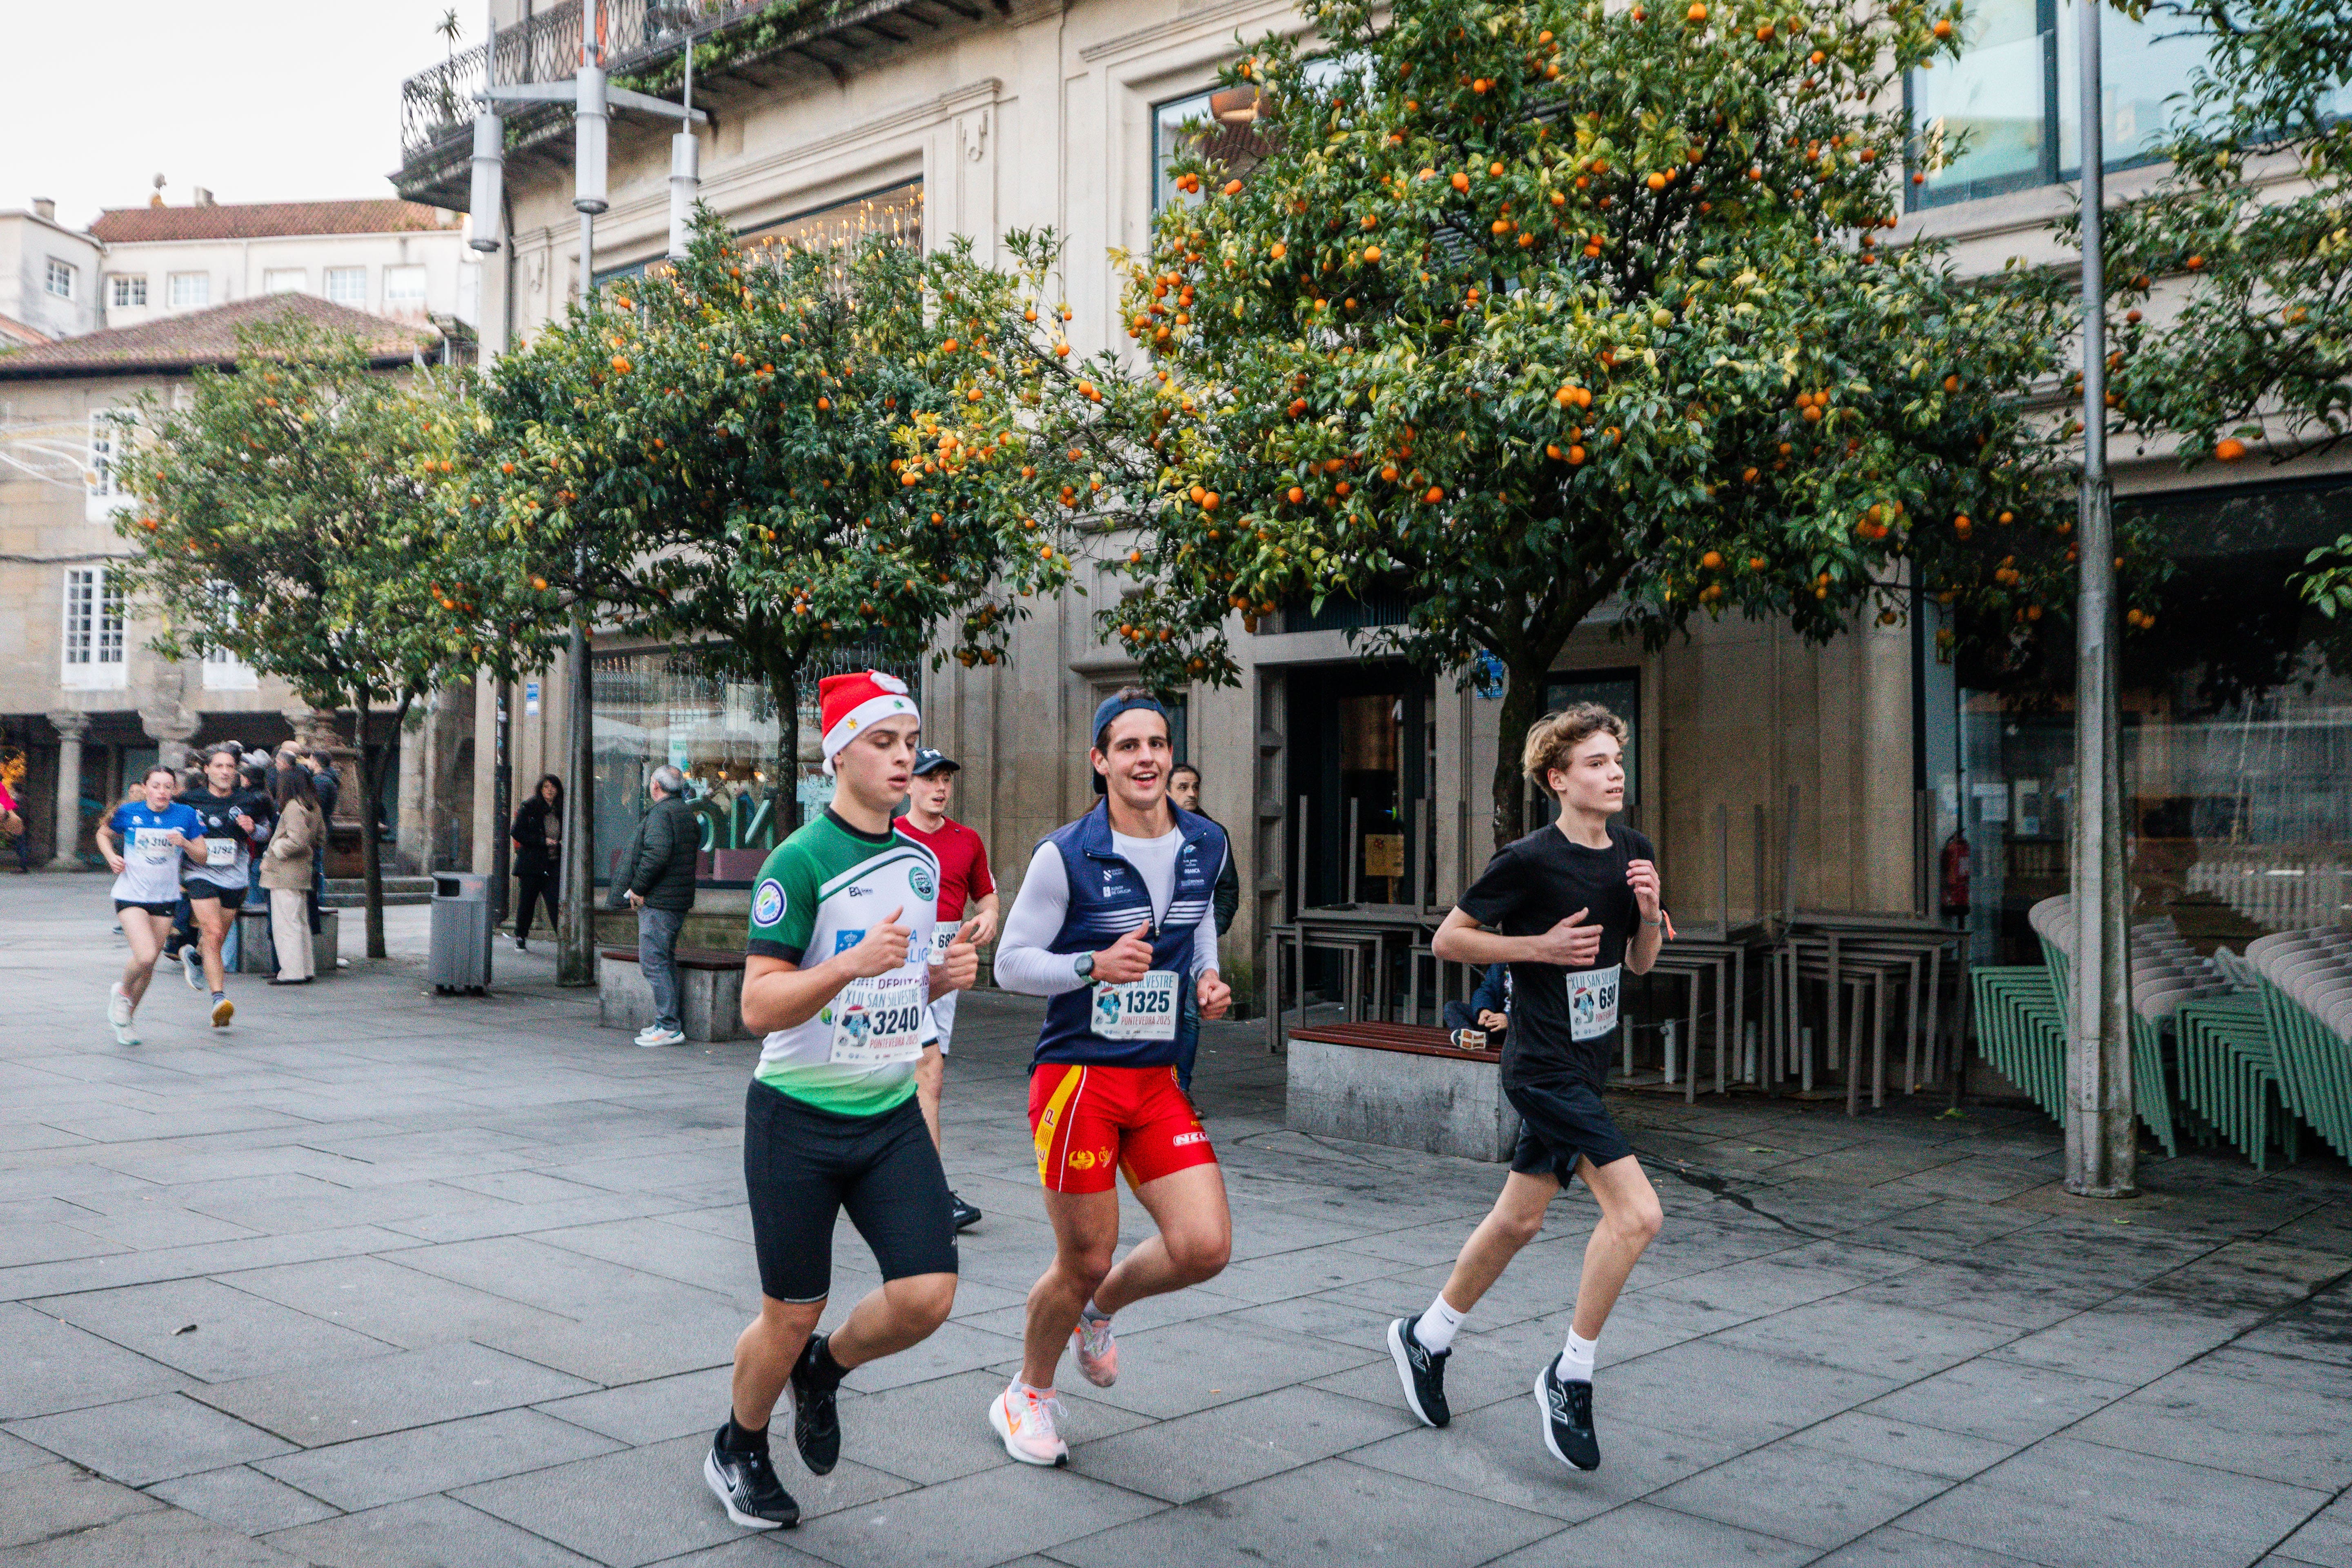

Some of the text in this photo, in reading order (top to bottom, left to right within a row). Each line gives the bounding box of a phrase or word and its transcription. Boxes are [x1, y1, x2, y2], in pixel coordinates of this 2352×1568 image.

[1571, 975, 1585, 990] XLII
[1587, 973, 1600, 987] SAN
[867, 992, 886, 1008] SAN
[888, 988, 918, 1007] SILVESTRE
[1126, 990, 1170, 1013] 1325
[1599, 983, 1616, 1009] 690
[873, 1005, 919, 1035] 3240
[1121, 1015, 1170, 1025] PONTEVEDRA 2025
[870, 1033, 918, 1049] PONTEVEDRA 2025
